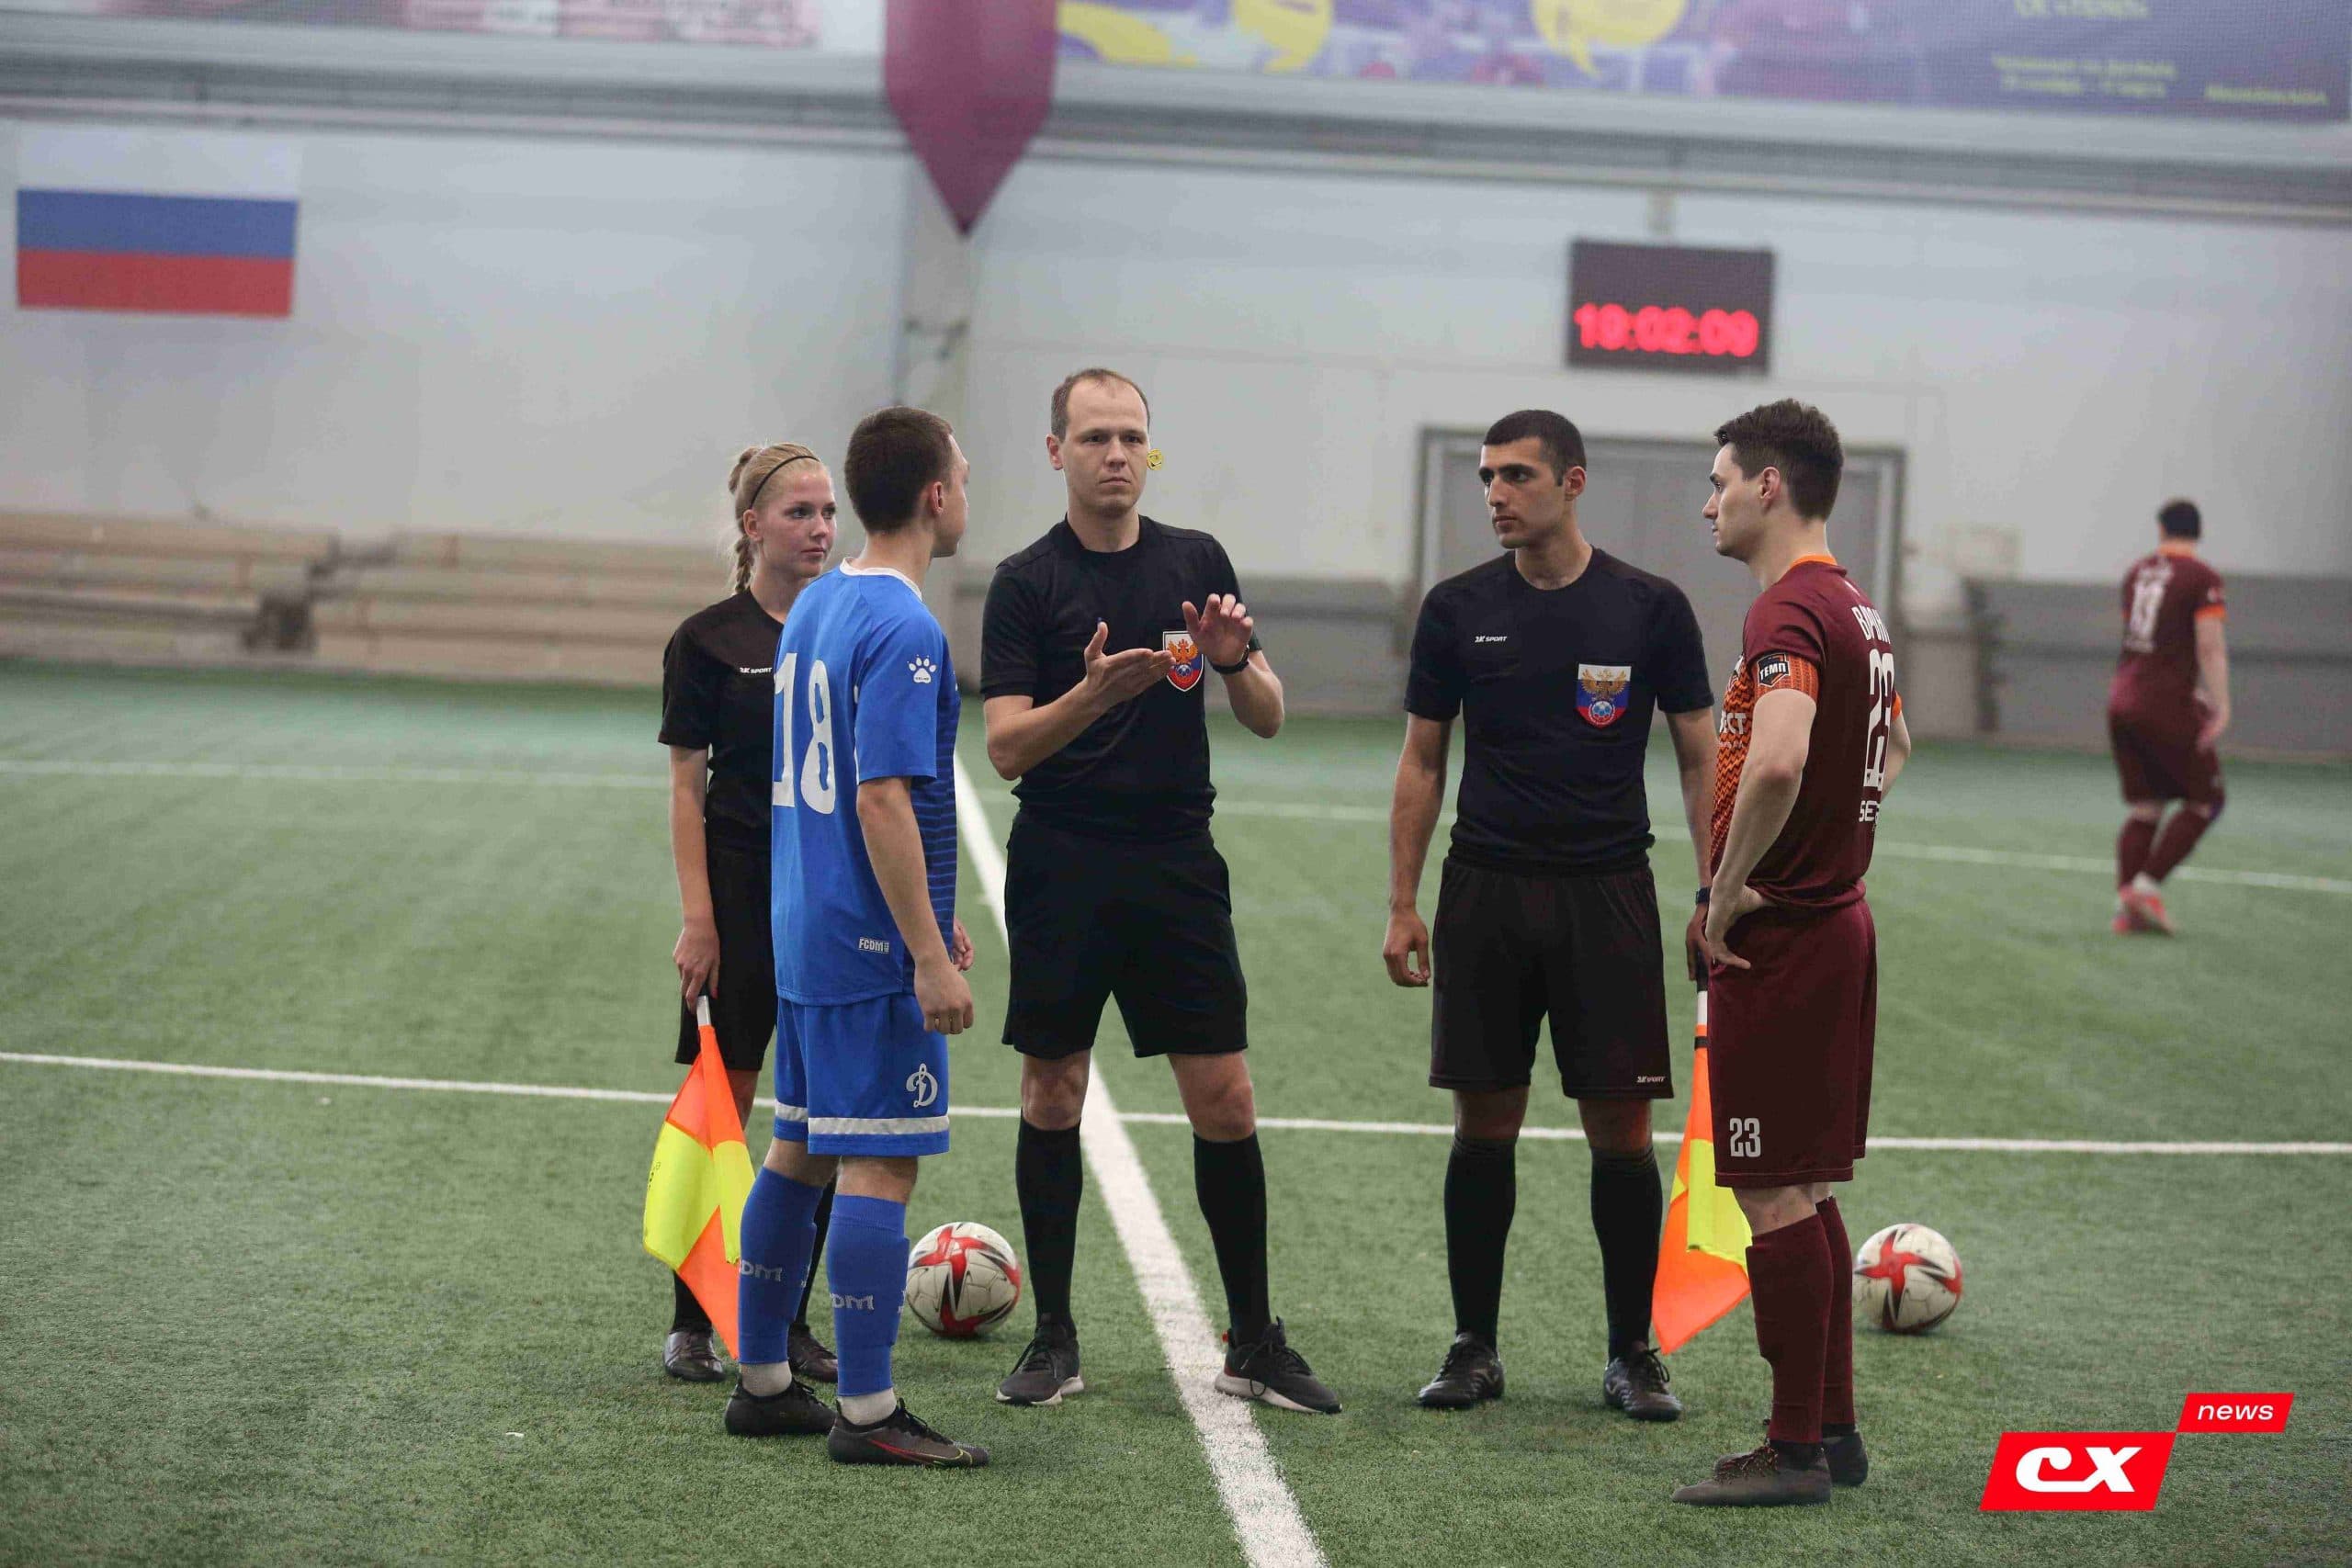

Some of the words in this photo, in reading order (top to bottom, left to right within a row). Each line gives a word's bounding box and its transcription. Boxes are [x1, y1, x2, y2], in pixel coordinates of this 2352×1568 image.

[1759, 662, 1787, 681] ТЕМП
[772, 652, 836, 815] 18
[1729, 1117, 1761, 1157] 23
